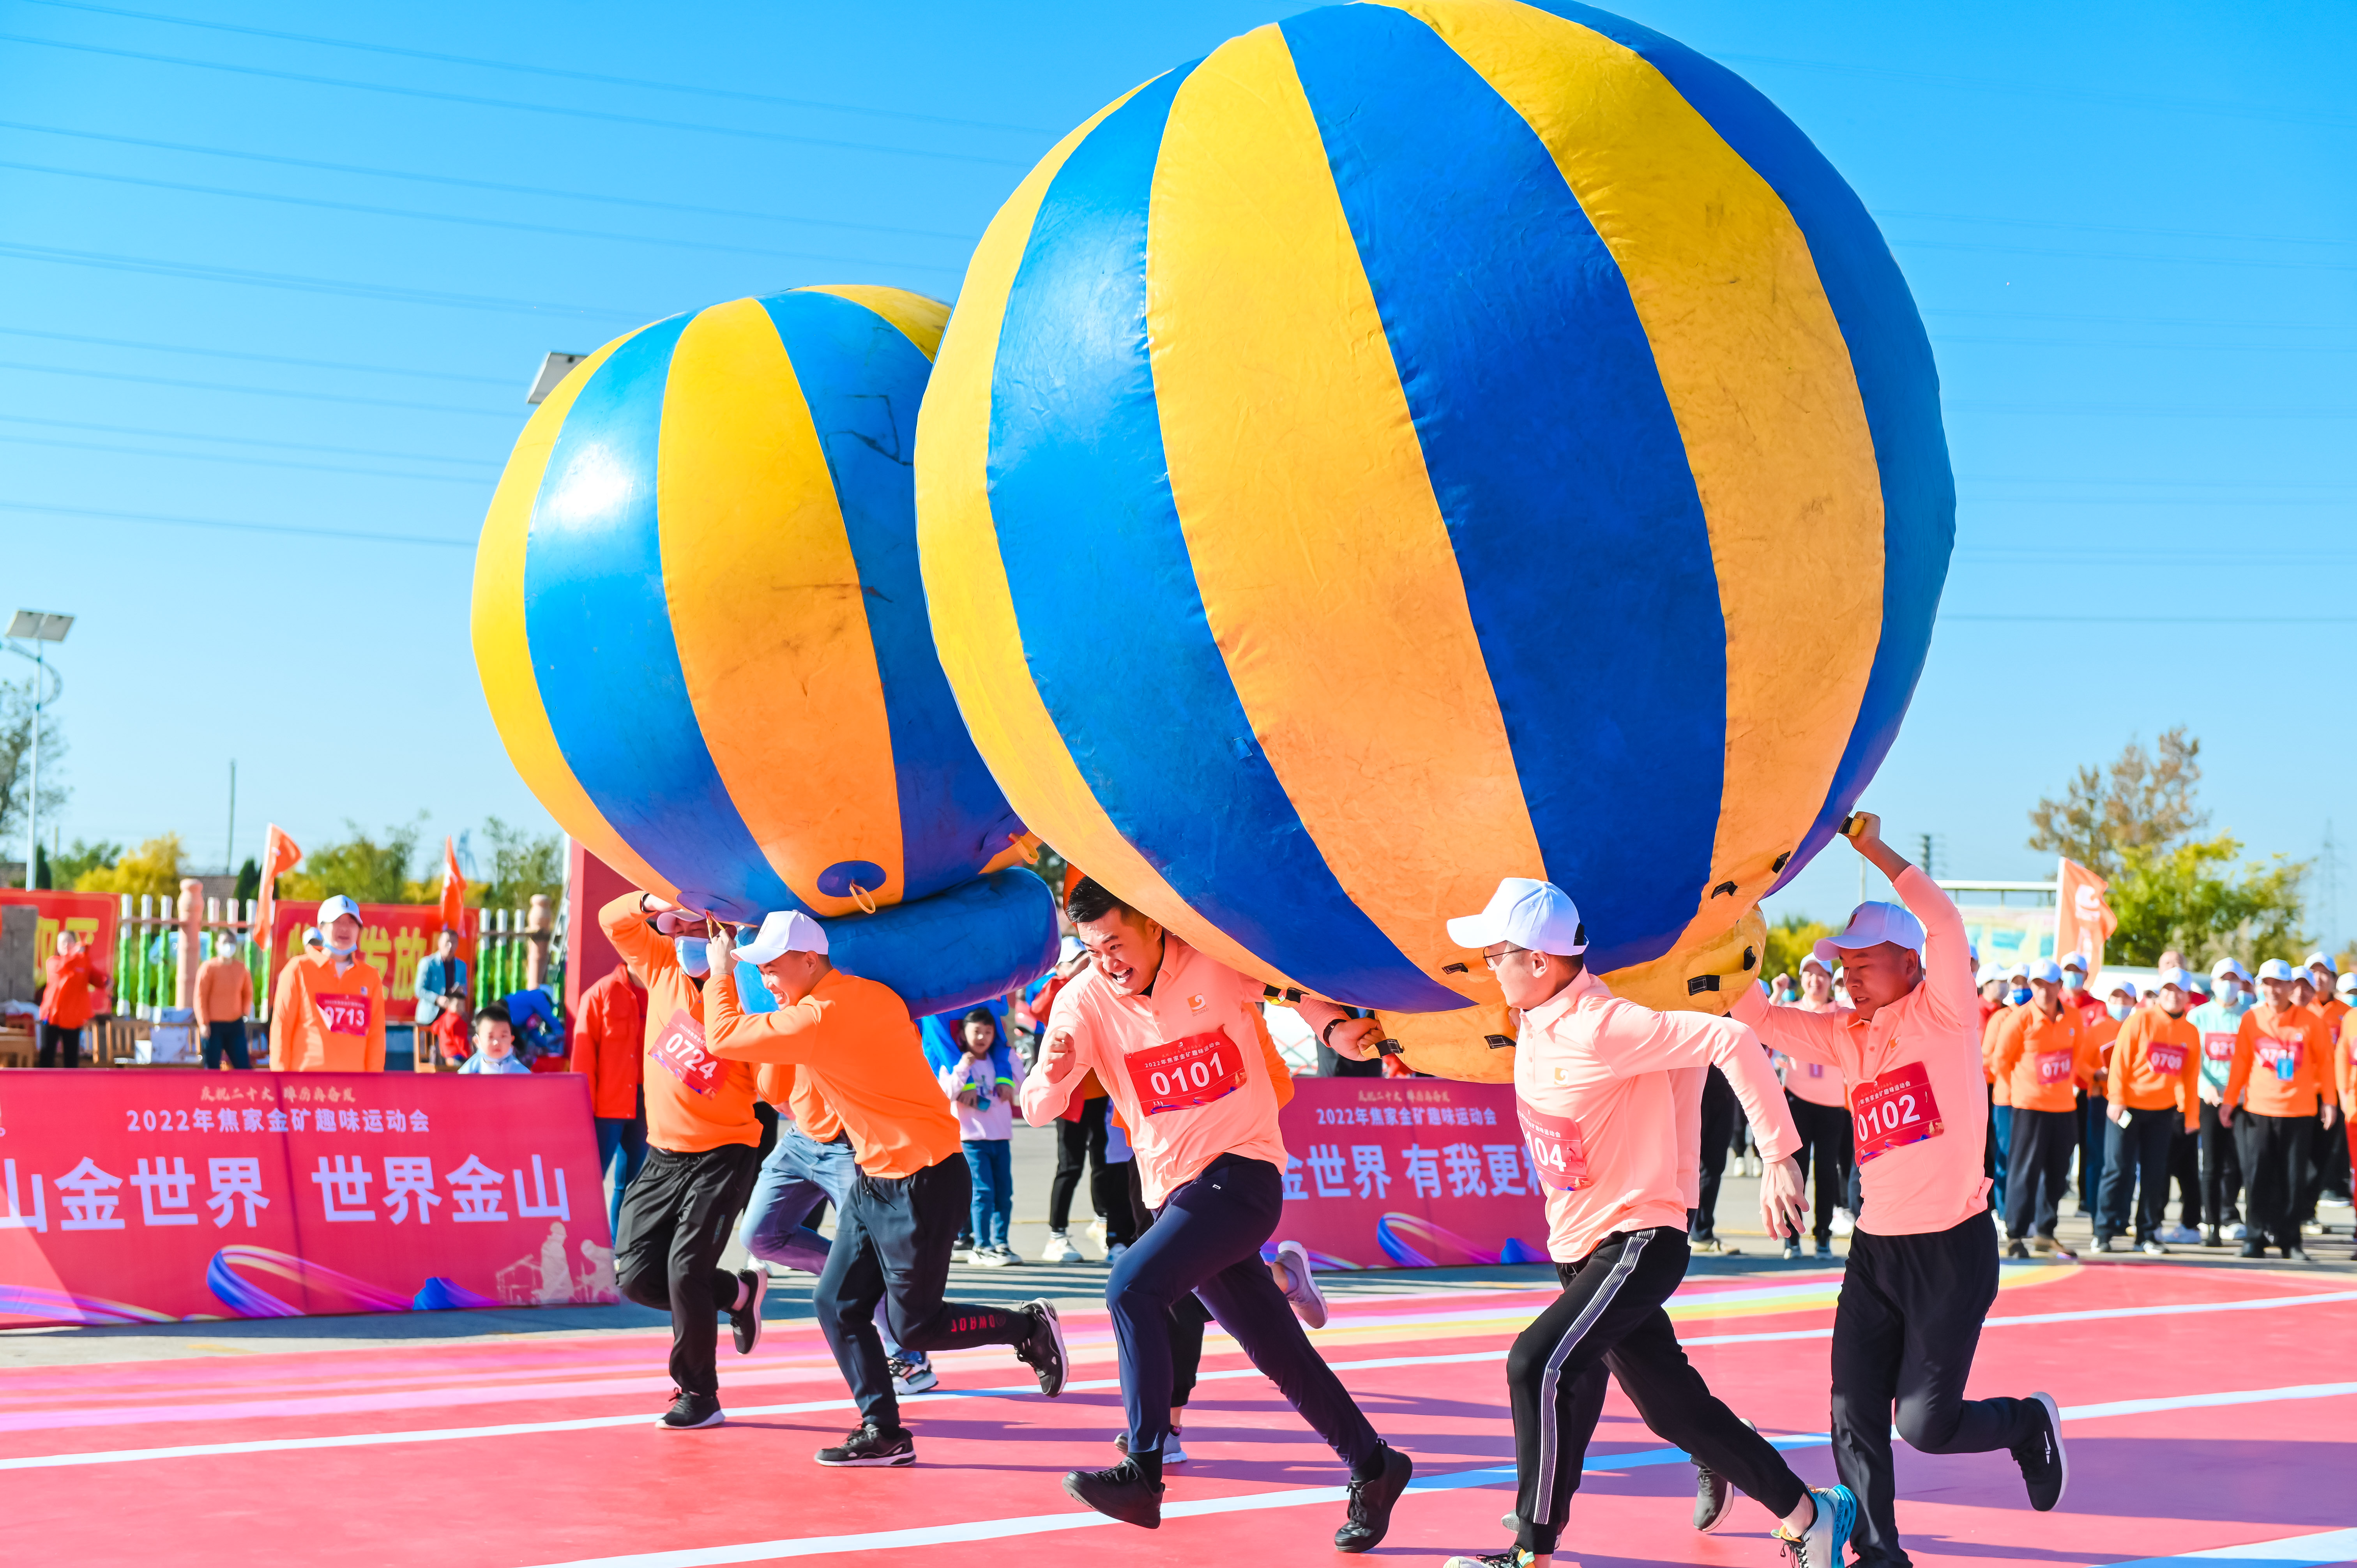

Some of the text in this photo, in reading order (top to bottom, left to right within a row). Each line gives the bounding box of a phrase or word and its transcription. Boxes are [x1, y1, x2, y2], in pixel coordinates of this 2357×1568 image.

[324, 1006, 365, 1027] 0713
[665, 1033, 718, 1080] 0724
[1144, 1041, 1221, 1068] 2022年焦家金矿趣味运动会
[1150, 1052, 1224, 1096] 0101
[126, 1107, 430, 1133] 2022年焦家金矿趣味运动会
[1857, 1094, 1921, 1142] 0102
[1520, 1122, 1567, 1172] 104
[312, 1154, 571, 1225] 世界金山
